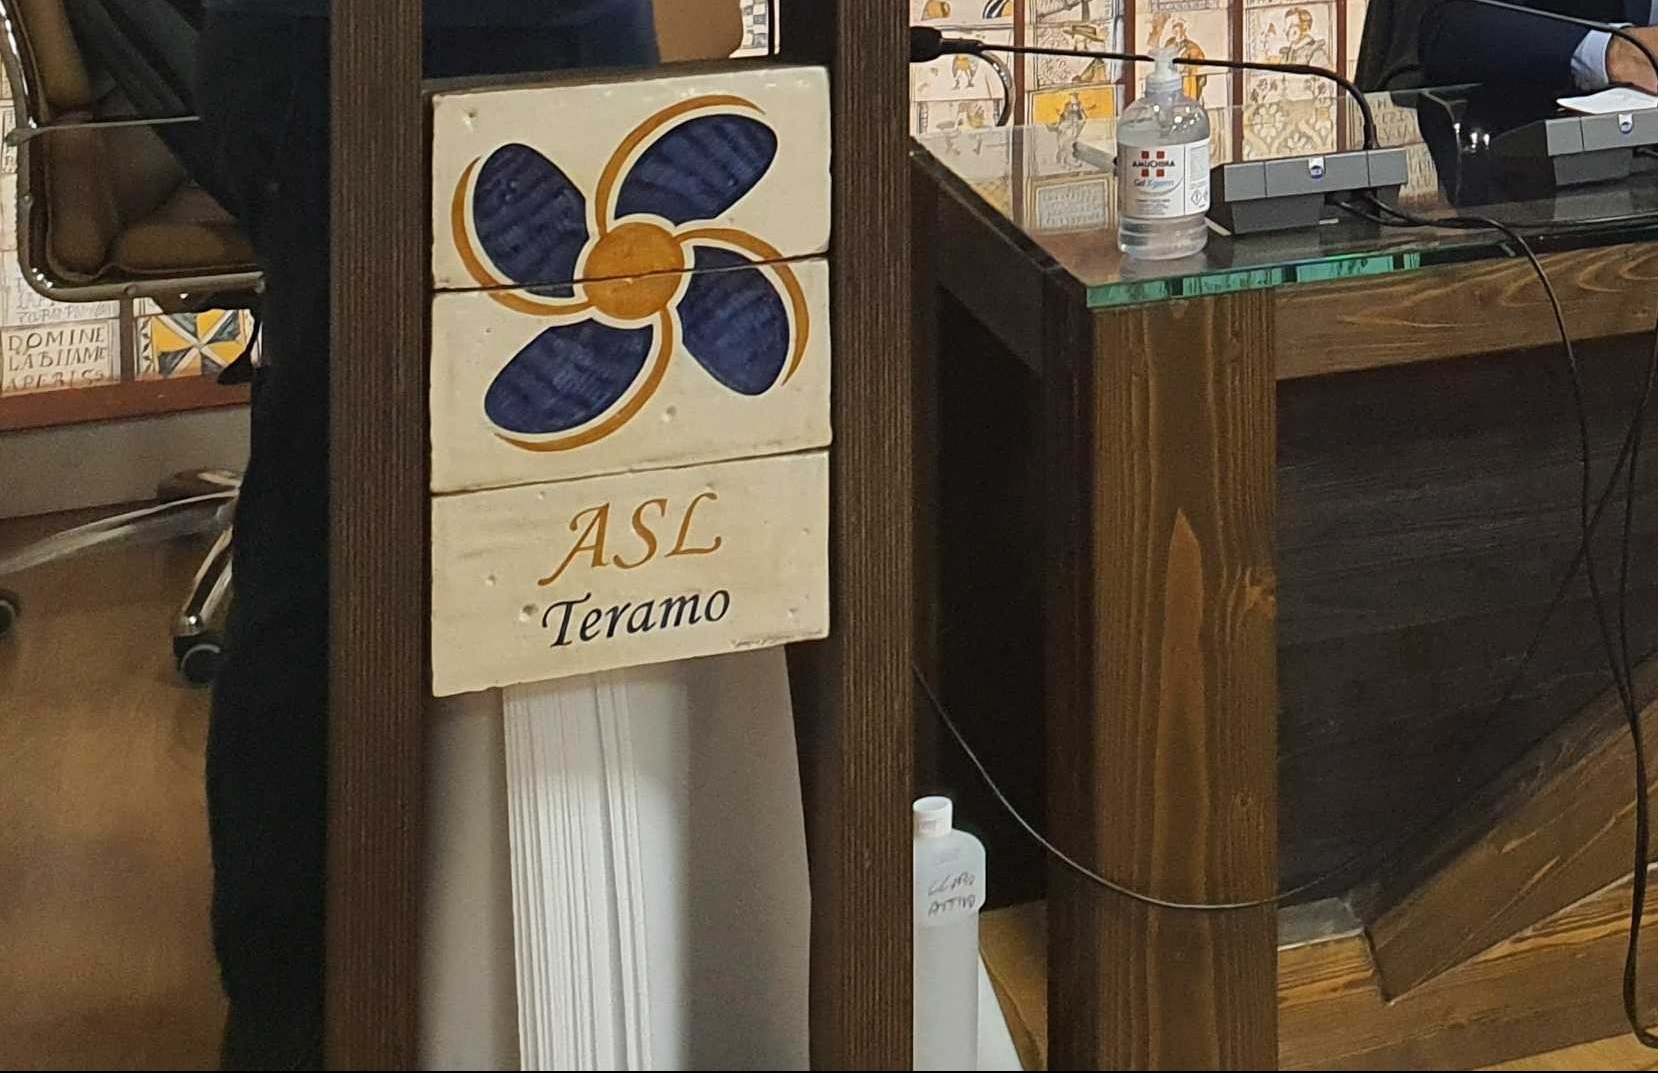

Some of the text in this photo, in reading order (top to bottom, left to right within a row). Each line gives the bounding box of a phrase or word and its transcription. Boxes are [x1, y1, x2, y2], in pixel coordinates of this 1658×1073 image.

[8, 327, 105, 354] DOMINE
[536, 492, 722, 586] ASL
[541, 589, 731, 648] Teramo
